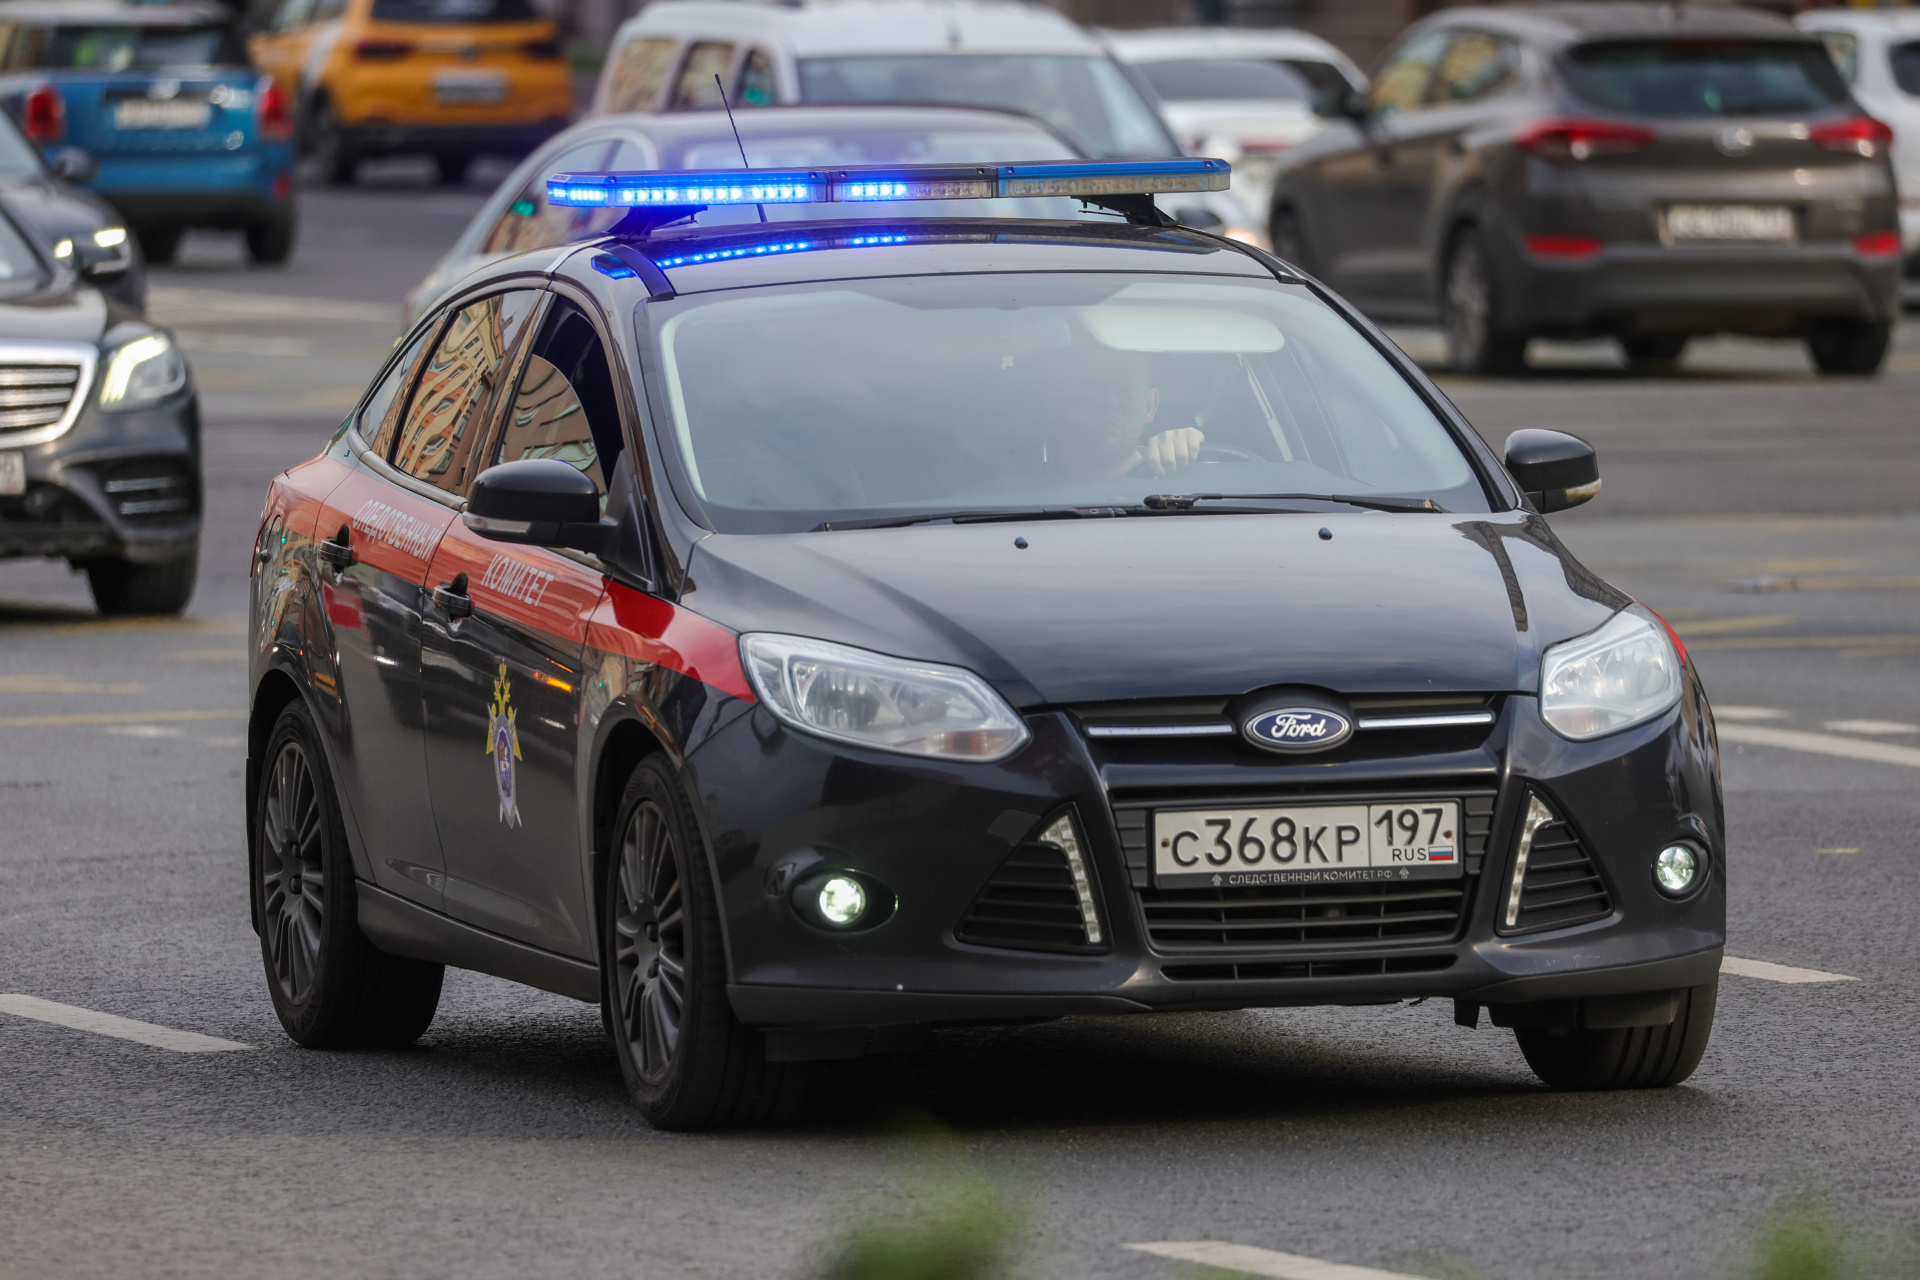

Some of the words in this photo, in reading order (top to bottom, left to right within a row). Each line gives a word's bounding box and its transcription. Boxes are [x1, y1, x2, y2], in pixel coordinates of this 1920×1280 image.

[352, 499, 446, 561] СЛЕДСТВЕННЫЙ
[480, 553, 555, 607] КОМИТЕТ
[1271, 713, 1327, 738] Ford
[1374, 807, 1444, 847] 197
[1392, 848, 1427, 862] RUS
[1229, 871, 1321, 884] СЛЕДСТВЕННЫЙ
[1323, 871, 1376, 881] КОМИТЕТ
[1377, 869, 1393, 880] РФ
